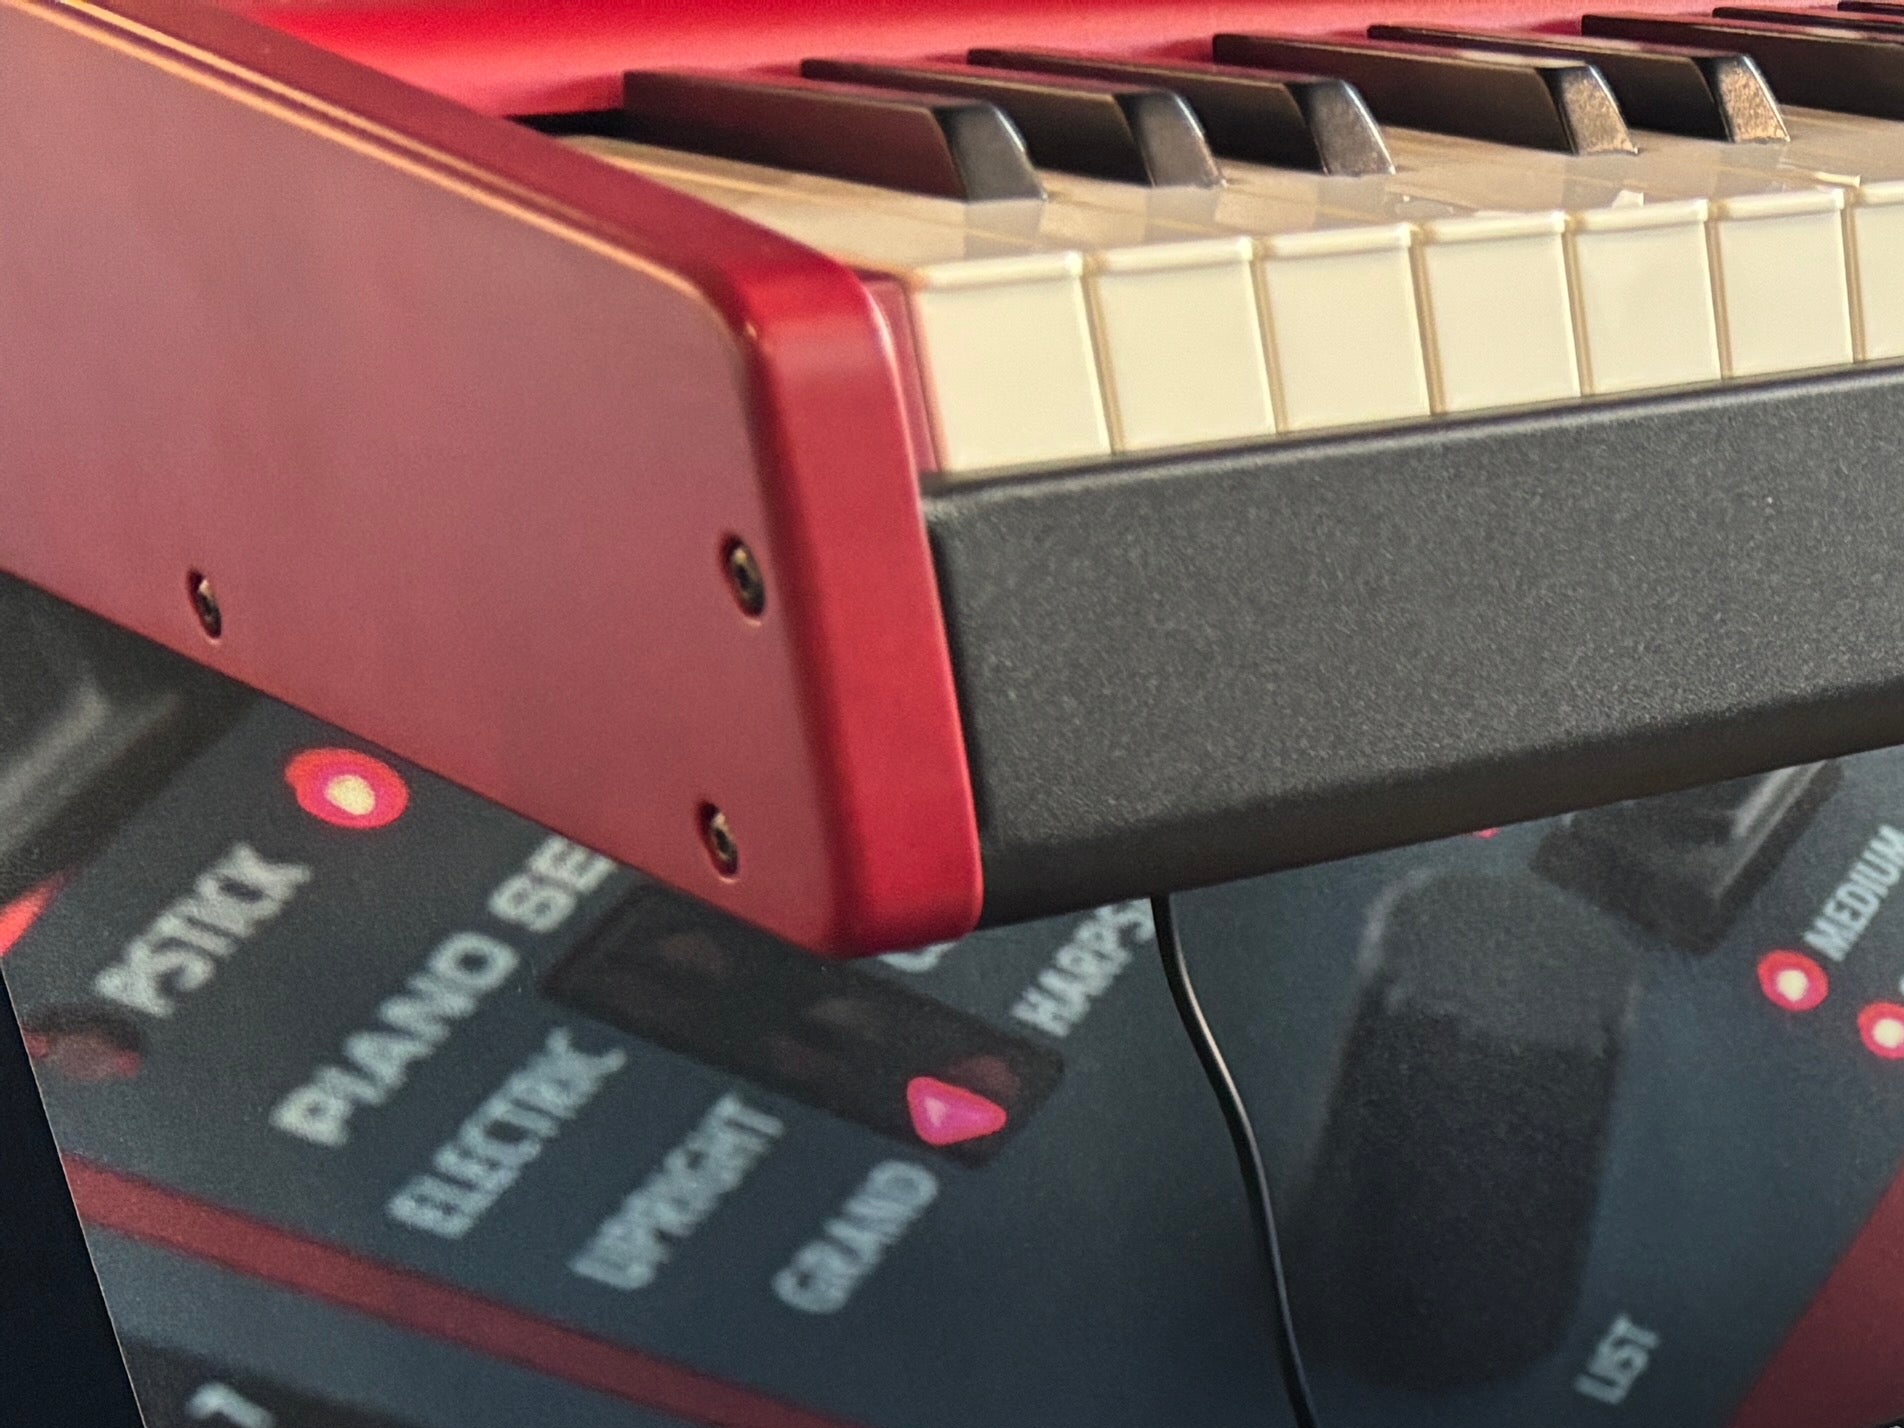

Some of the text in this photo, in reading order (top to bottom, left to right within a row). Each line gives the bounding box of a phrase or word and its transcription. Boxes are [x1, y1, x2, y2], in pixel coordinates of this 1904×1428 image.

[269, 931, 520, 1147] PIANO
[387, 1026, 627, 1239] ELECTRIC
[565, 1092, 785, 1291] UPRIGHT
[772, 1159, 939, 1313] GRAND
[1574, 1312, 1660, 1405] LIST
